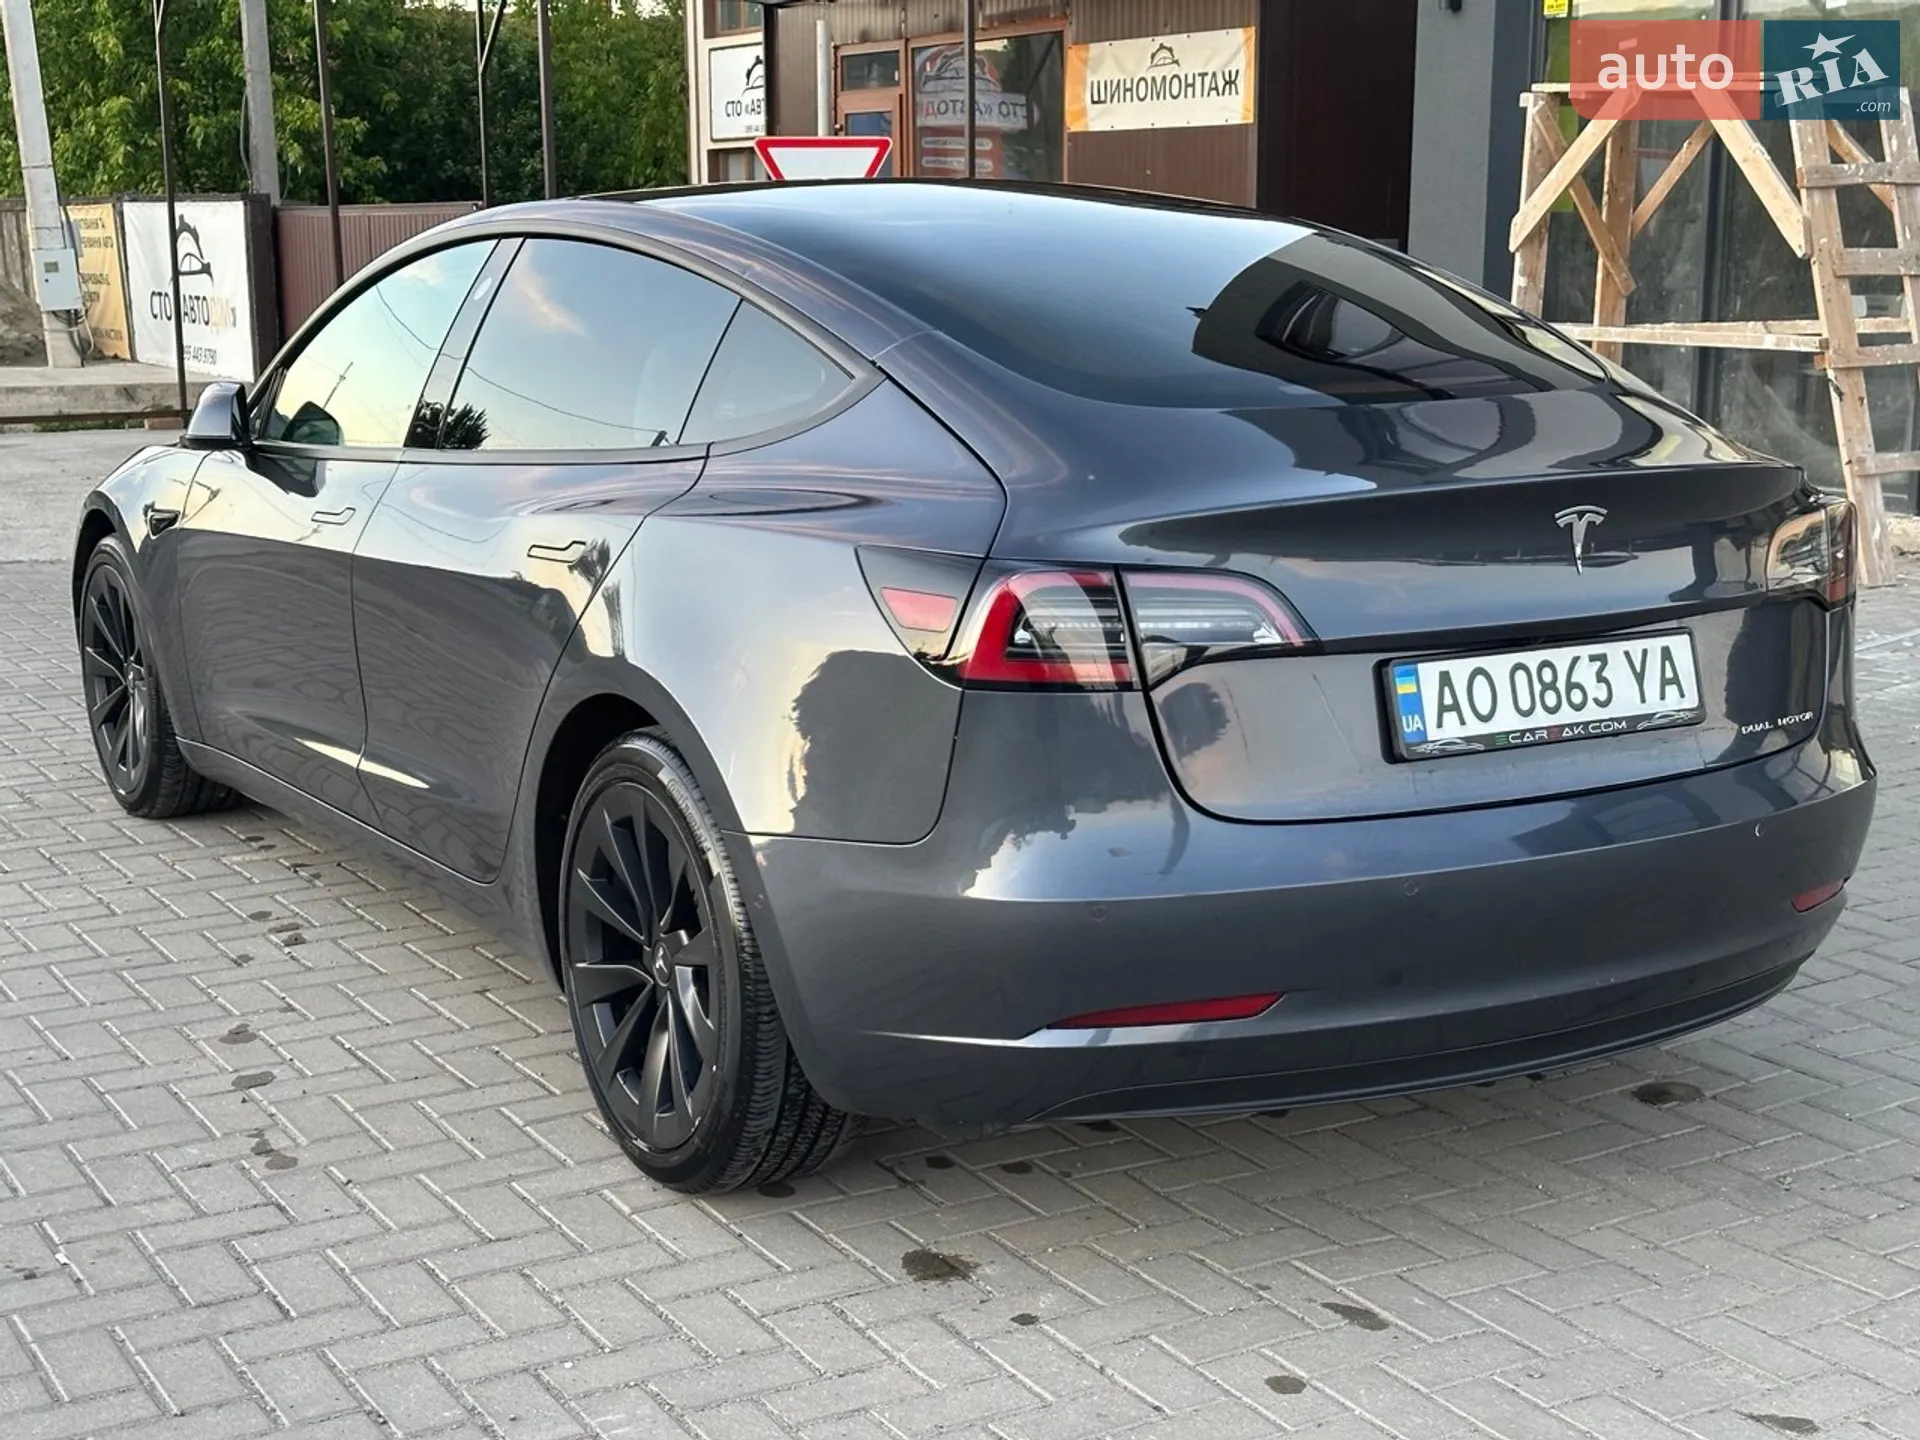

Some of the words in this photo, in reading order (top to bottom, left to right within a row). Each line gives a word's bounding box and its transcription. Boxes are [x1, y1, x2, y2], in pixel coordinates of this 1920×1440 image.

[1090, 69, 1240, 104] ШИНОМОНТАЖ
[724, 99, 743, 117] СТО
[150, 290, 172, 321] СТО
[1436, 667, 1498, 728] AO
[1509, 653, 1613, 718] 0863
[1624, 645, 1685, 704] YA
[1402, 714, 1424, 733] UA
[1741, 721, 1774, 735] DUAL
[1777, 711, 1814, 727] MOTOR
